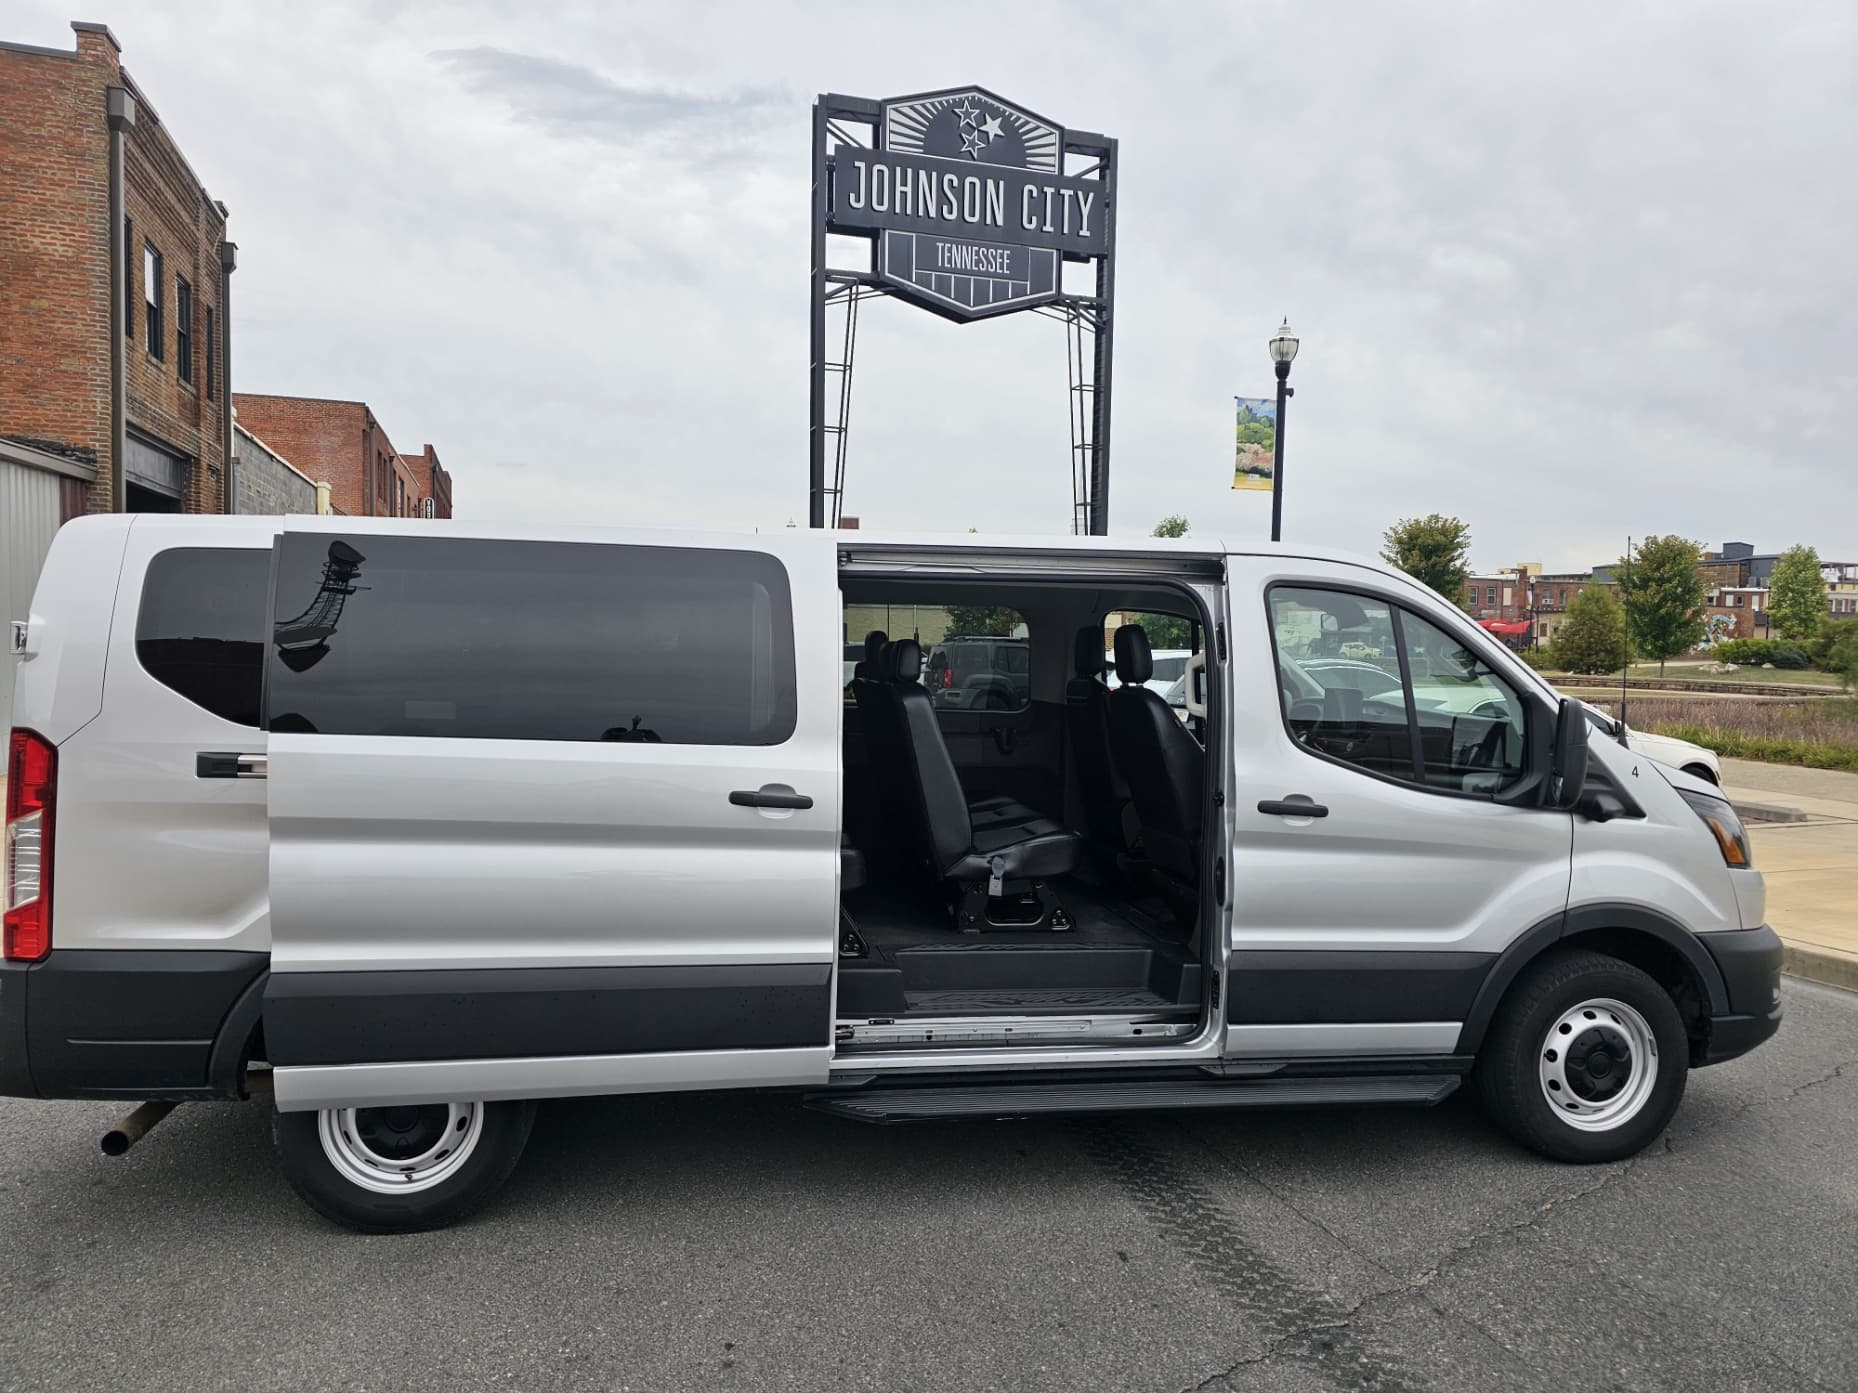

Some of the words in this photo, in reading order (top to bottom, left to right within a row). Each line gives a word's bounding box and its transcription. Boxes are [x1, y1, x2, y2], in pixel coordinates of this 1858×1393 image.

[849, 161, 1005, 227] JOHNSON
[1022, 184, 1095, 237] CITY
[936, 242, 1011, 274] TENNESSEE
[1631, 765, 1639, 779] 4
